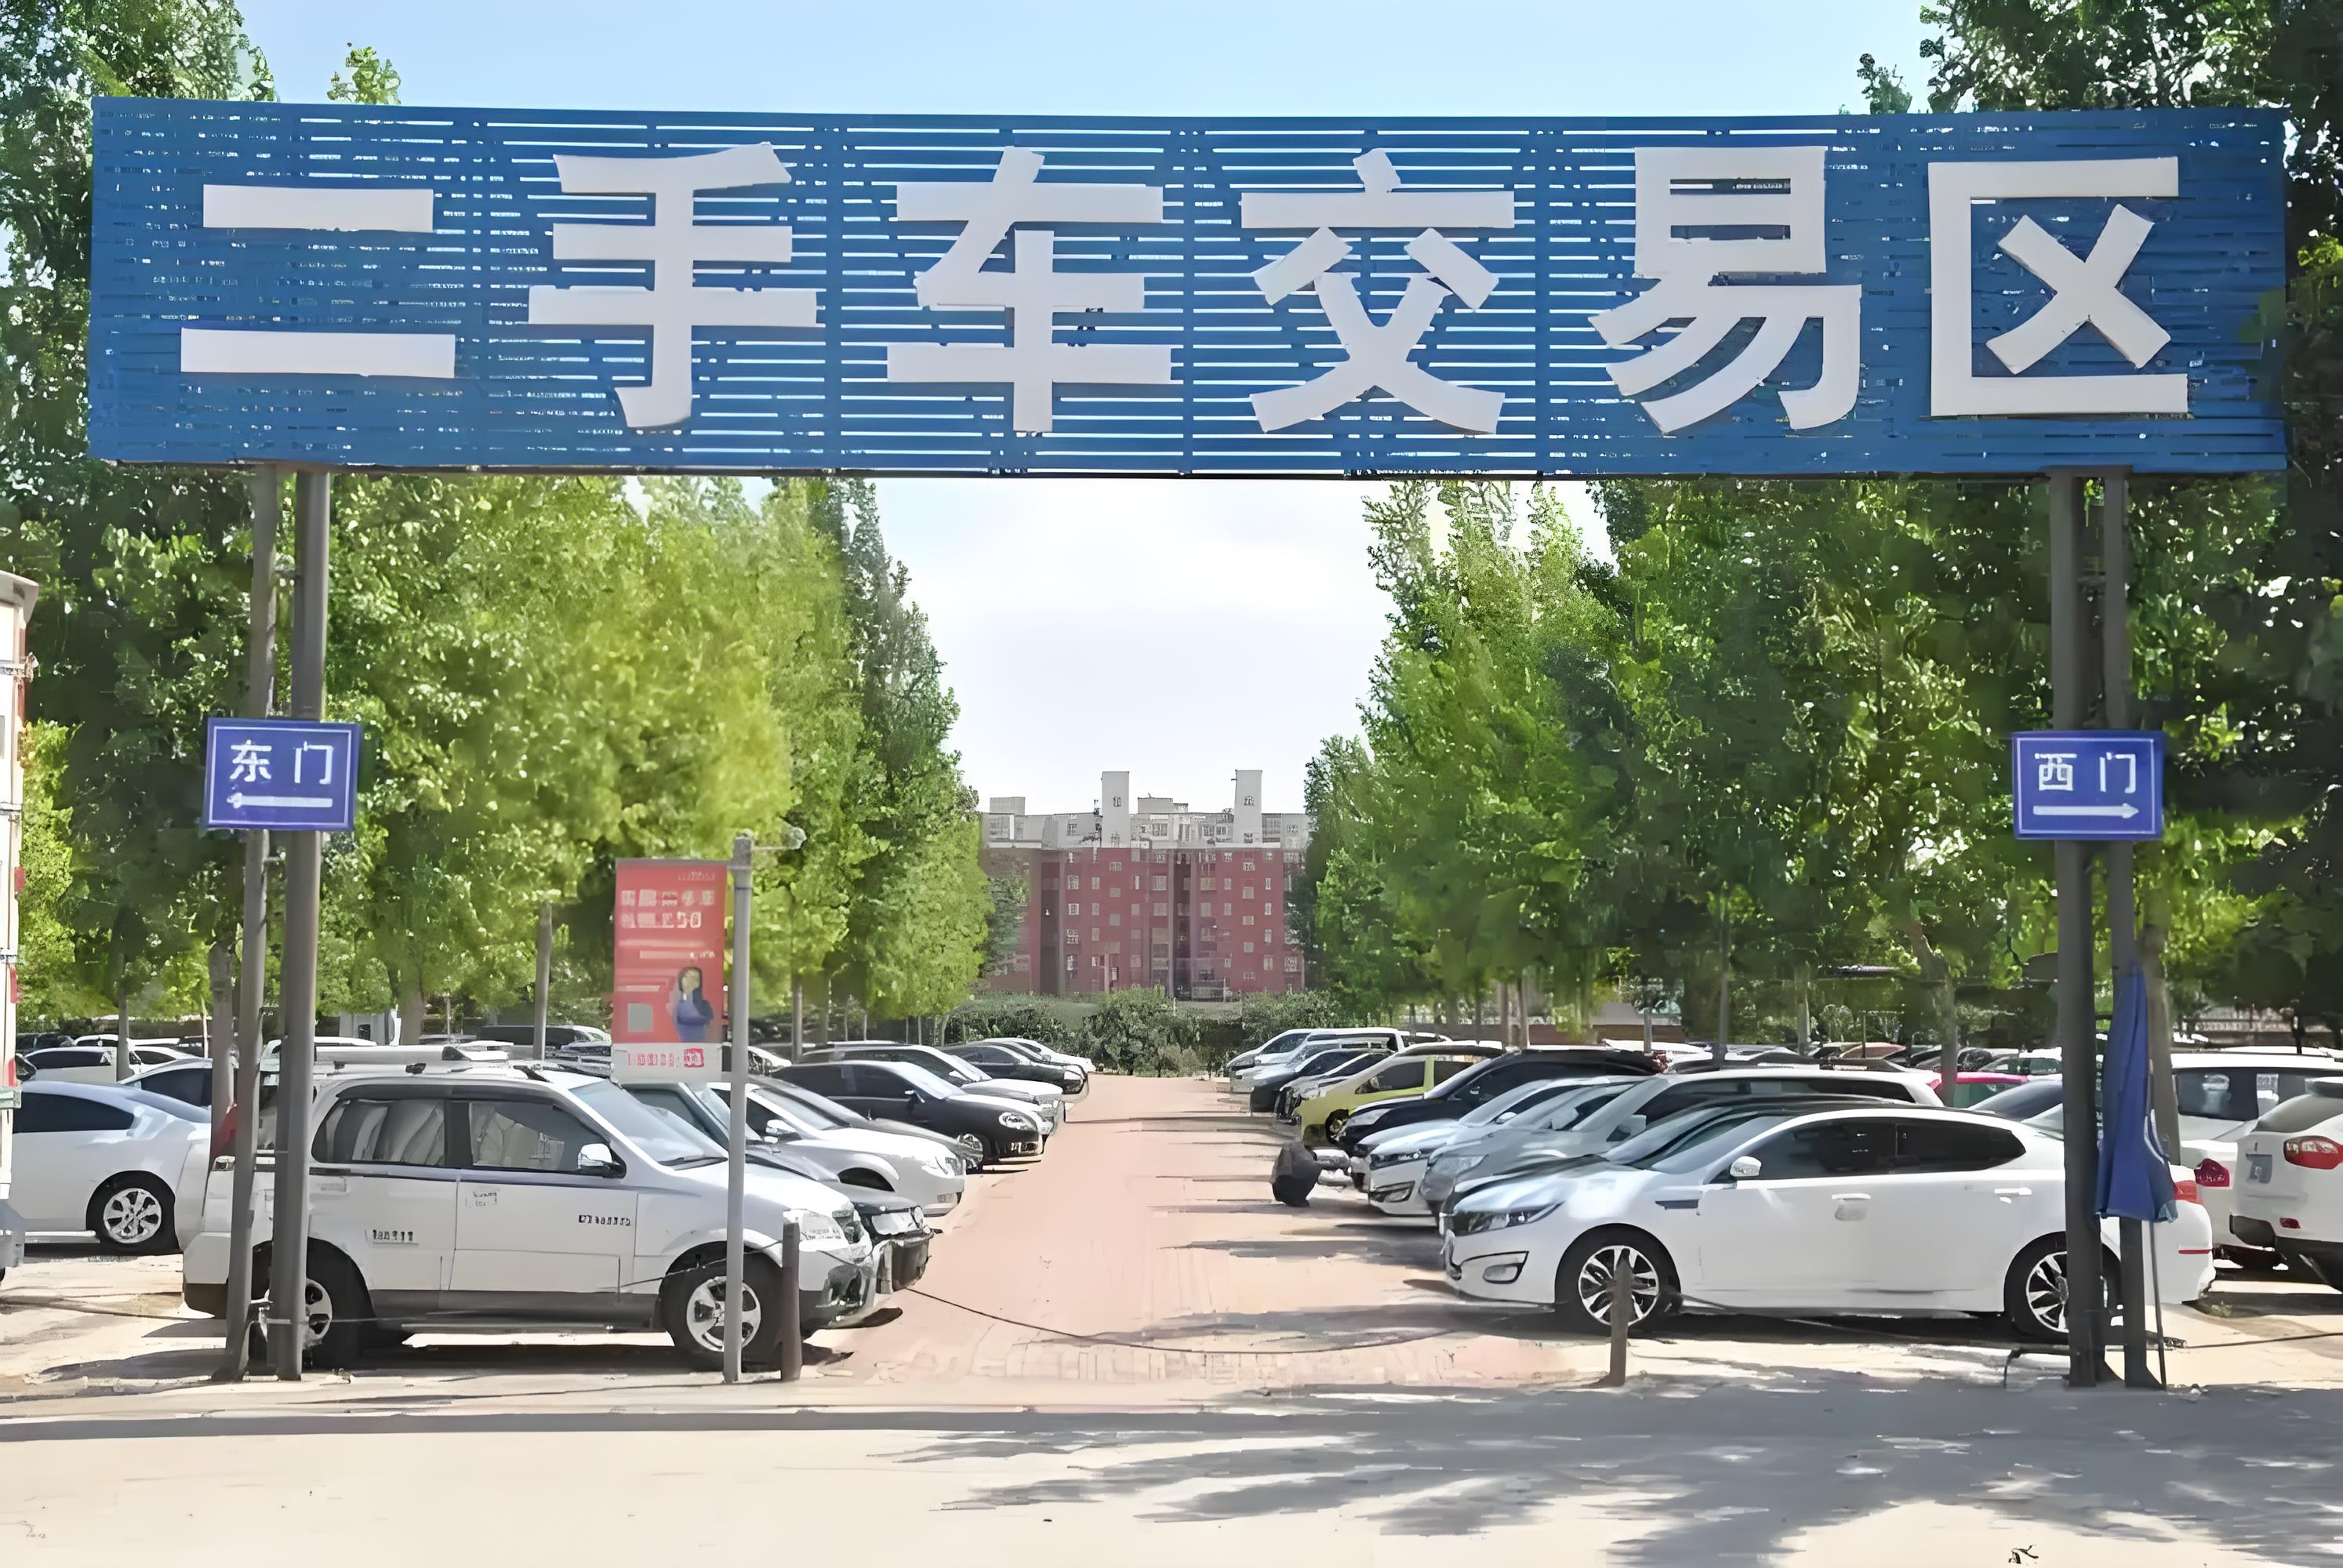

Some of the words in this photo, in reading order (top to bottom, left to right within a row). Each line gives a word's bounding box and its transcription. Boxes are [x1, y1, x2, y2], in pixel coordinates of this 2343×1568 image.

[179, 142, 2190, 434] 二手车交易区
[230, 739, 333, 785] 东门
[2034, 751, 2137, 794] 西门
